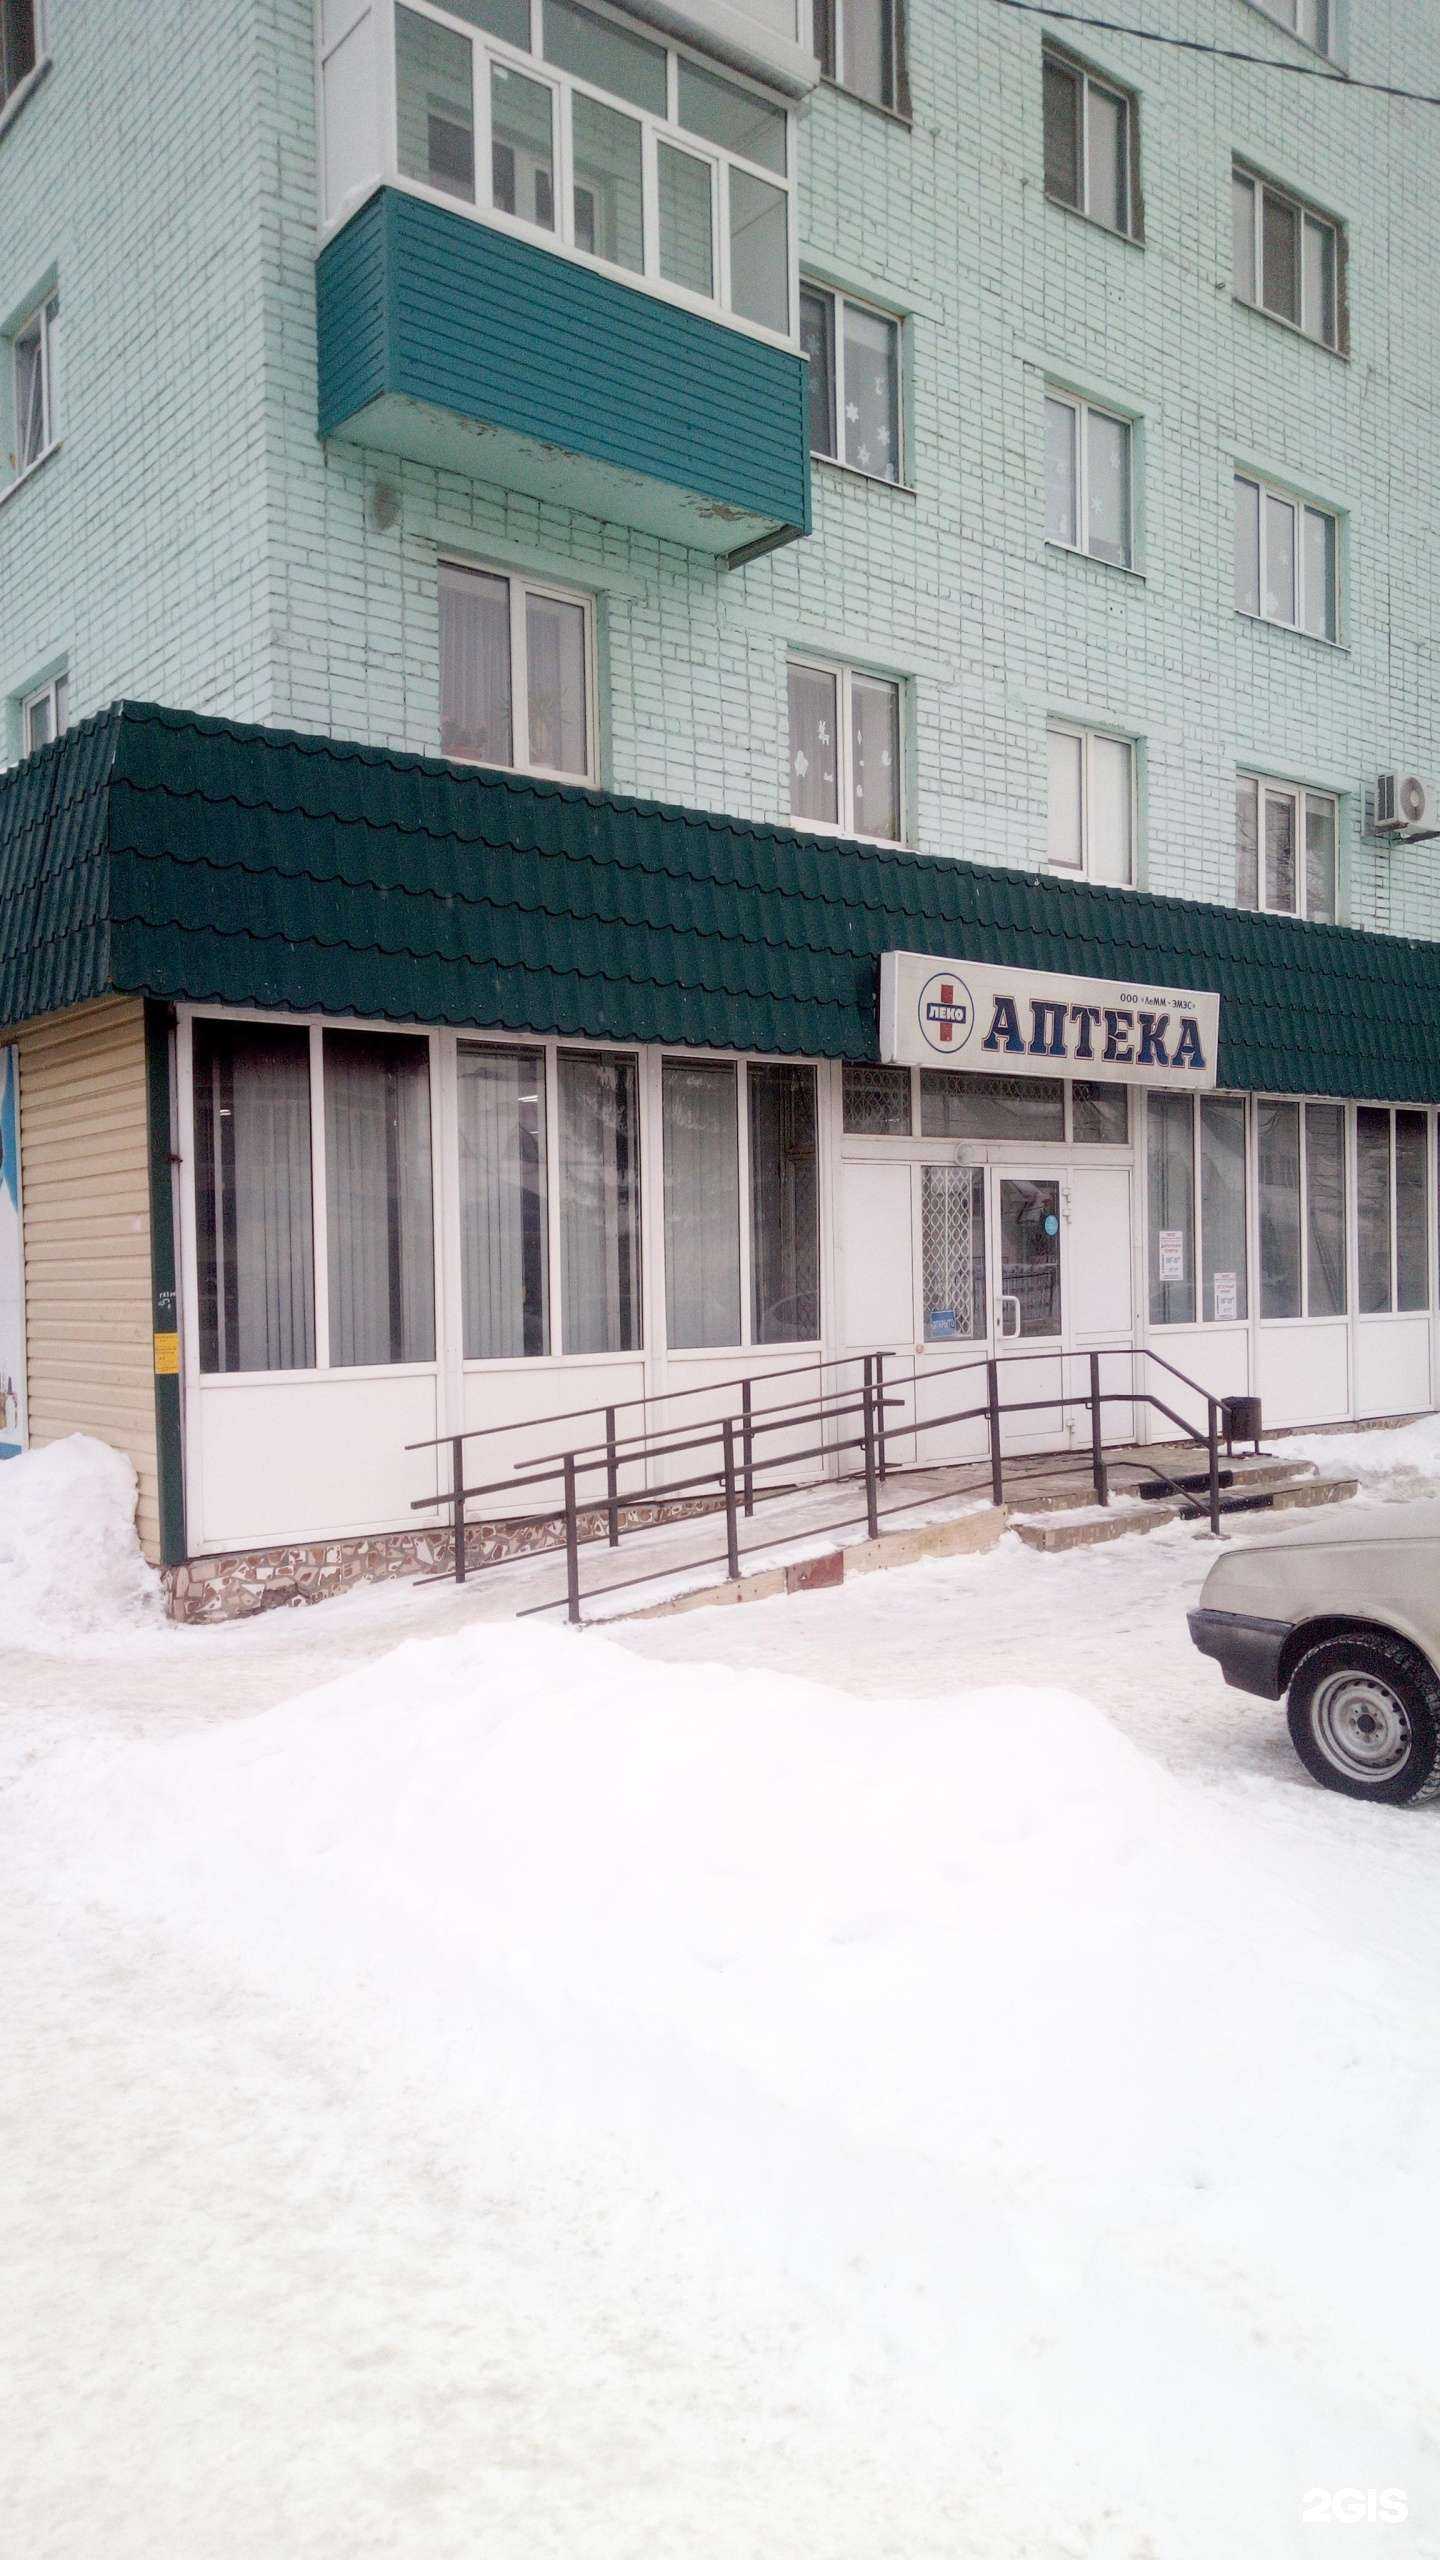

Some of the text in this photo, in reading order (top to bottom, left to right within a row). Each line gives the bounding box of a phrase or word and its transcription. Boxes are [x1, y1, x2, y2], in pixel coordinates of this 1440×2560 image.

[1120, 993, 1138, 1003] ООО
[929, 1005, 964, 1021] ЛЕКО
[981, 994, 1206, 1069] АПТЕКА
